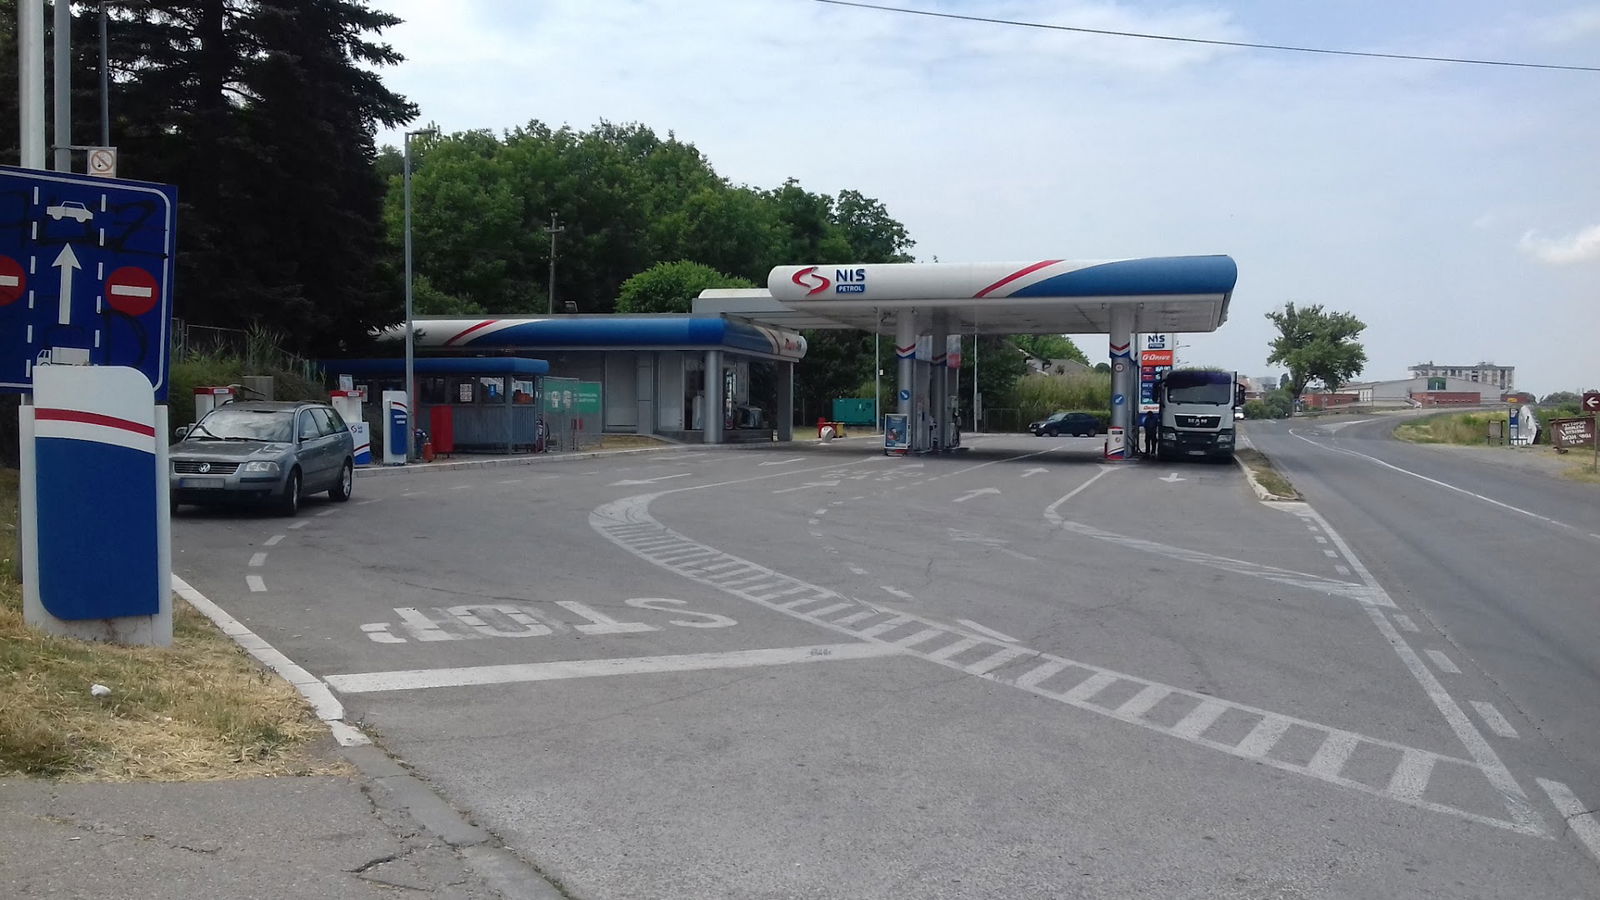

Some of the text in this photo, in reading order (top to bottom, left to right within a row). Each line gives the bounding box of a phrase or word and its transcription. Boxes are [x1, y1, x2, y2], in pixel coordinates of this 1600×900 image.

[836, 268, 865, 282] NIS
[1148, 335, 1165, 343] NIS
[359, 597, 739, 643] STOP
